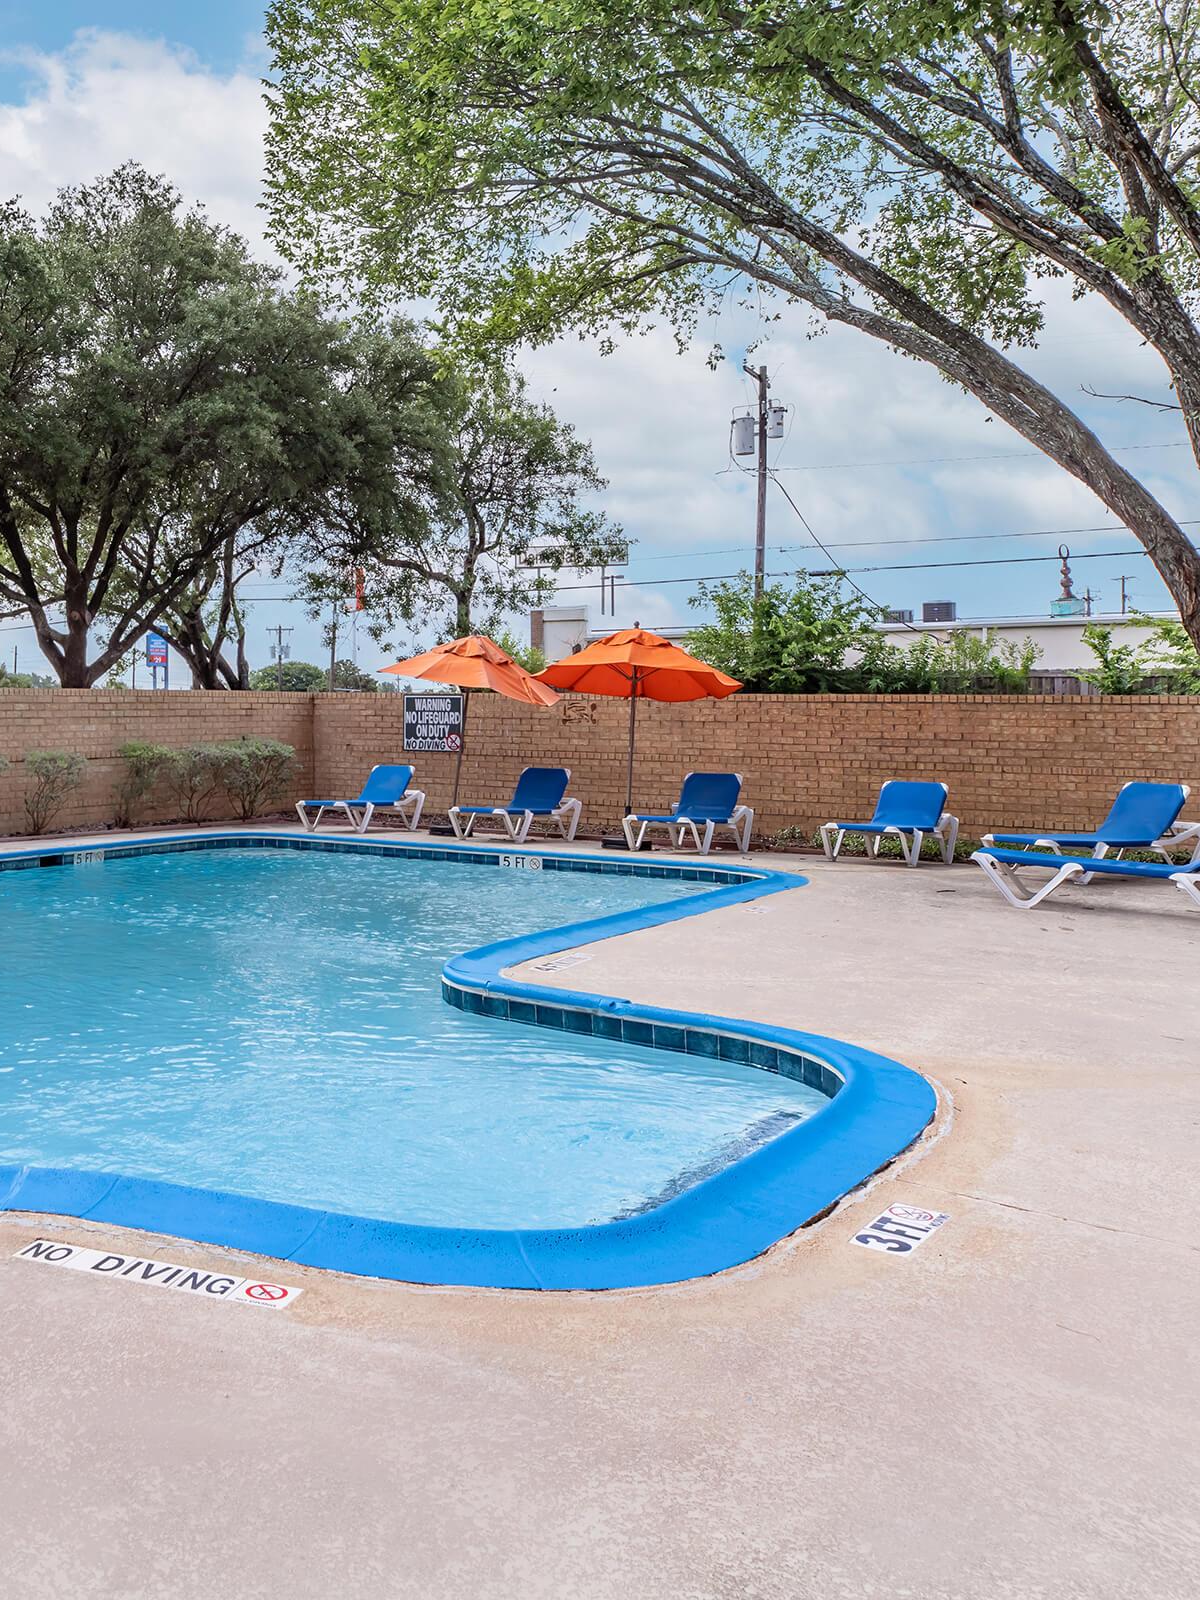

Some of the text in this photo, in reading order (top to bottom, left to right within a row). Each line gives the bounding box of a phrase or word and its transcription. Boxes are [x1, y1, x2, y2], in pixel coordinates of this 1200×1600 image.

[414, 698, 452, 711] WARNING
[405, 711, 461, 724] NO LIFEGUARD
[416, 725, 450, 738] ON DUTY
[405, 740, 446, 750] NO DIVING
[503, 856, 526, 868] 5 FT
[20, 1243, 235, 1295] NO DIVING
